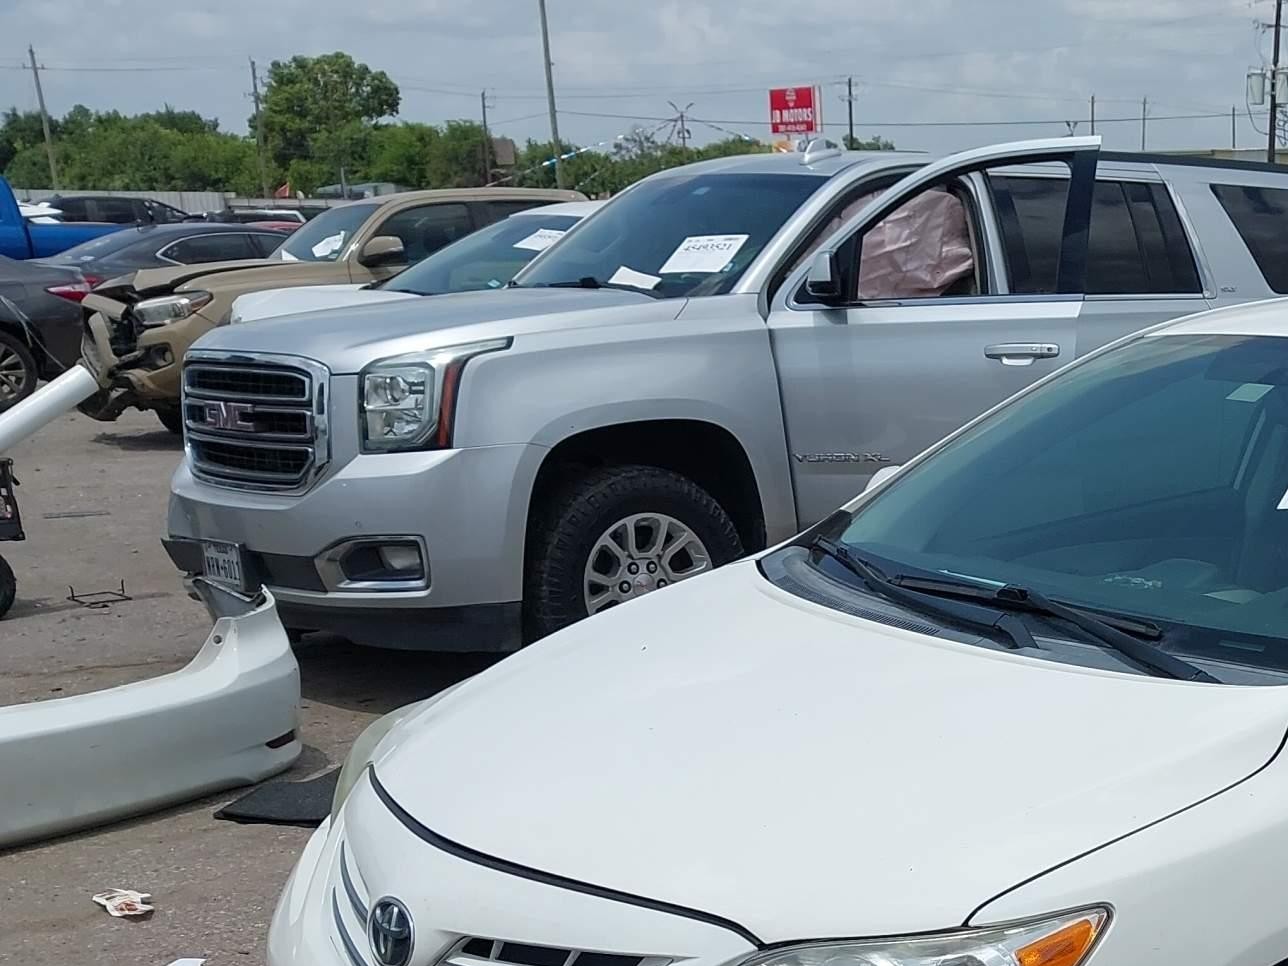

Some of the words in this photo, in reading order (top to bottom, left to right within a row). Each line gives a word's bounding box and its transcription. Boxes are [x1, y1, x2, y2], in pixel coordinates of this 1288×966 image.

[782, 107, 813, 122] MOTORS
[204, 400, 255, 431] GMC
[792, 452, 860, 463] YUKON
[863, 452, 891, 463] XL
